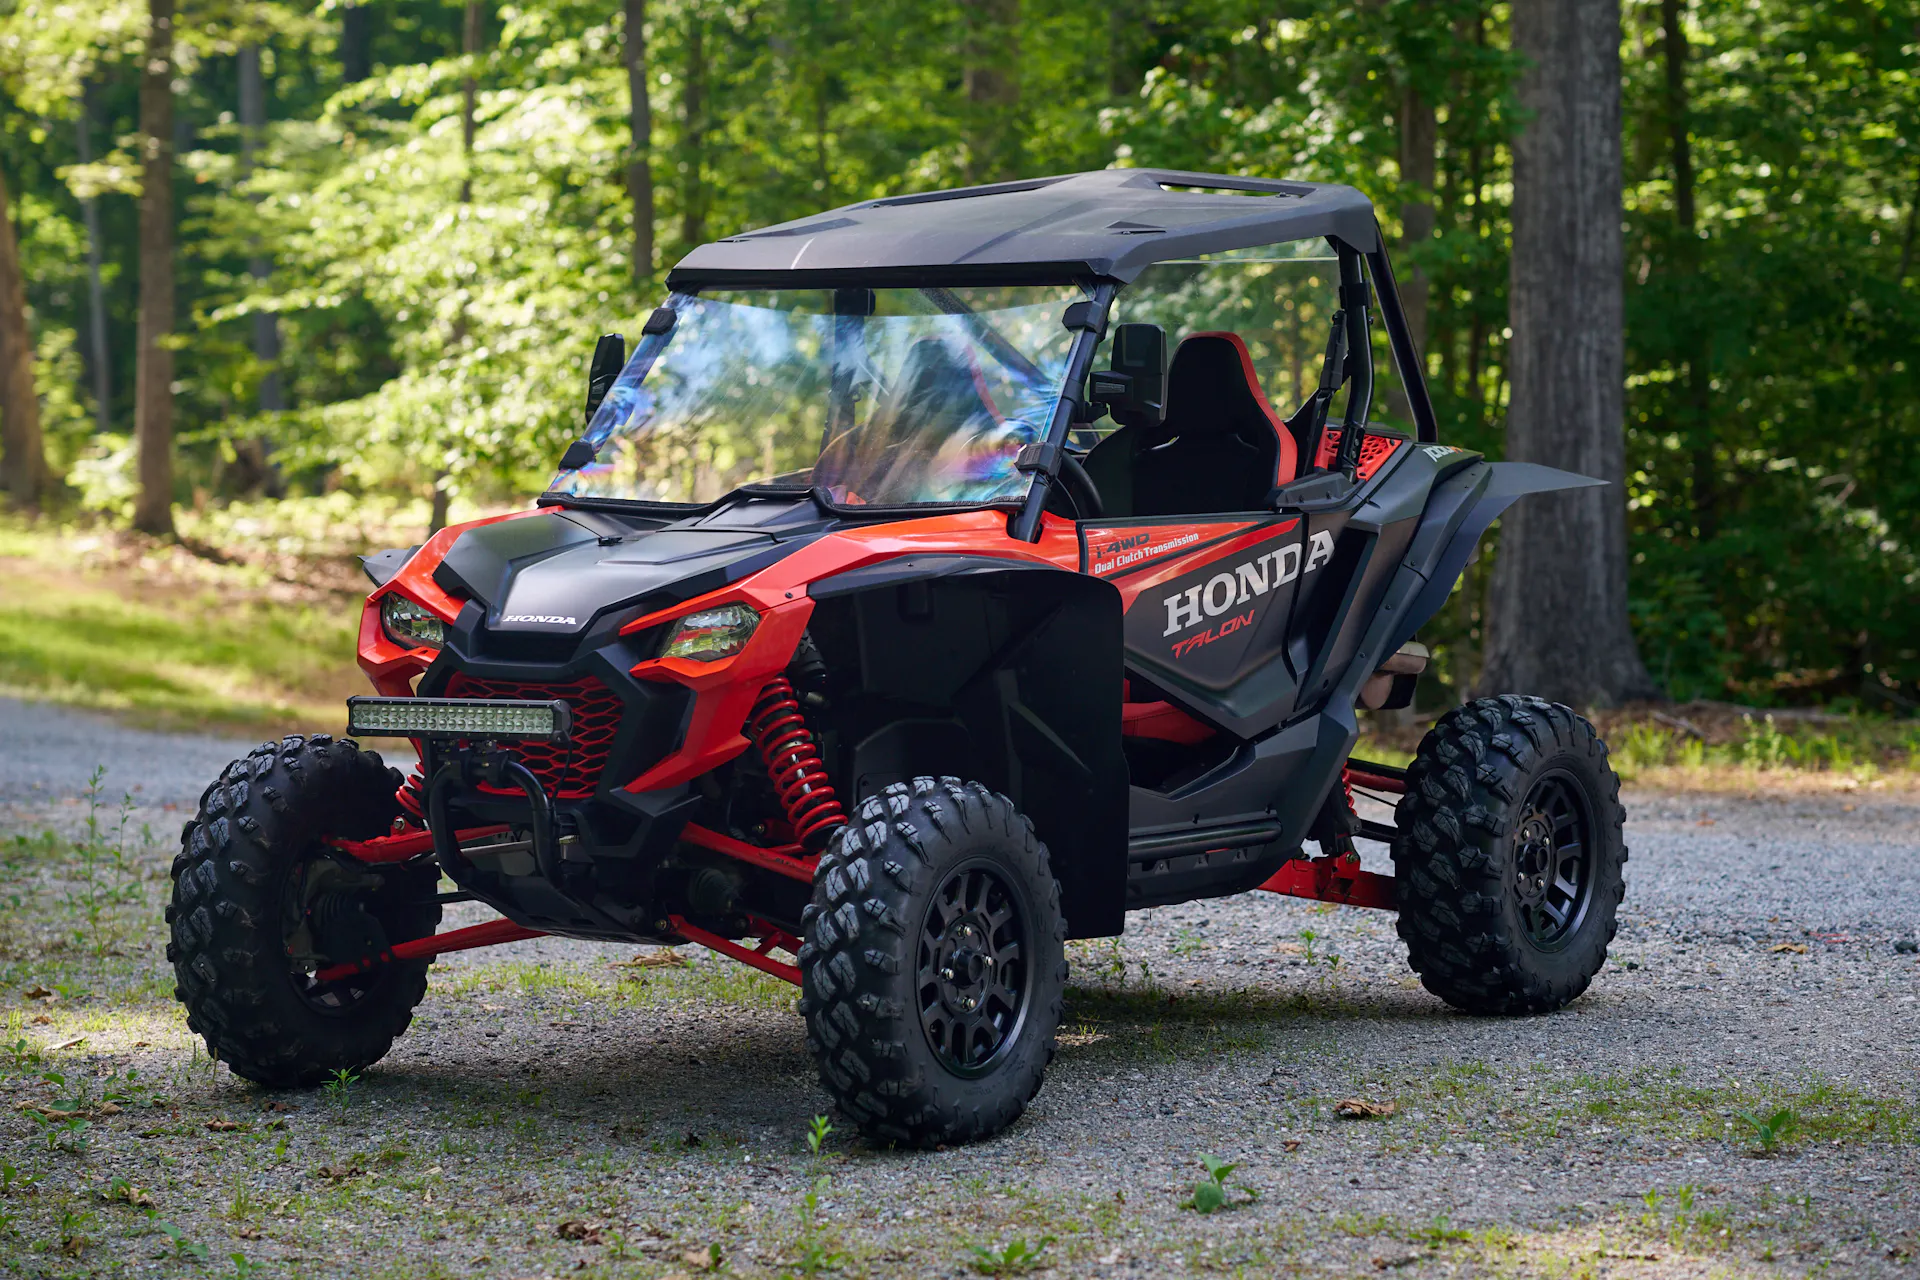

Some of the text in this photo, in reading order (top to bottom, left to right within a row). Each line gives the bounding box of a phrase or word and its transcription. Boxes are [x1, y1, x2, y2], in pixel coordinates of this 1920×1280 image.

[1095, 533, 1200, 574] Dual Clutch Transmission
[1164, 530, 1335, 637] HONDA
[502, 615, 577, 625] HONDA
[1172, 610, 1255, 659] TALON
